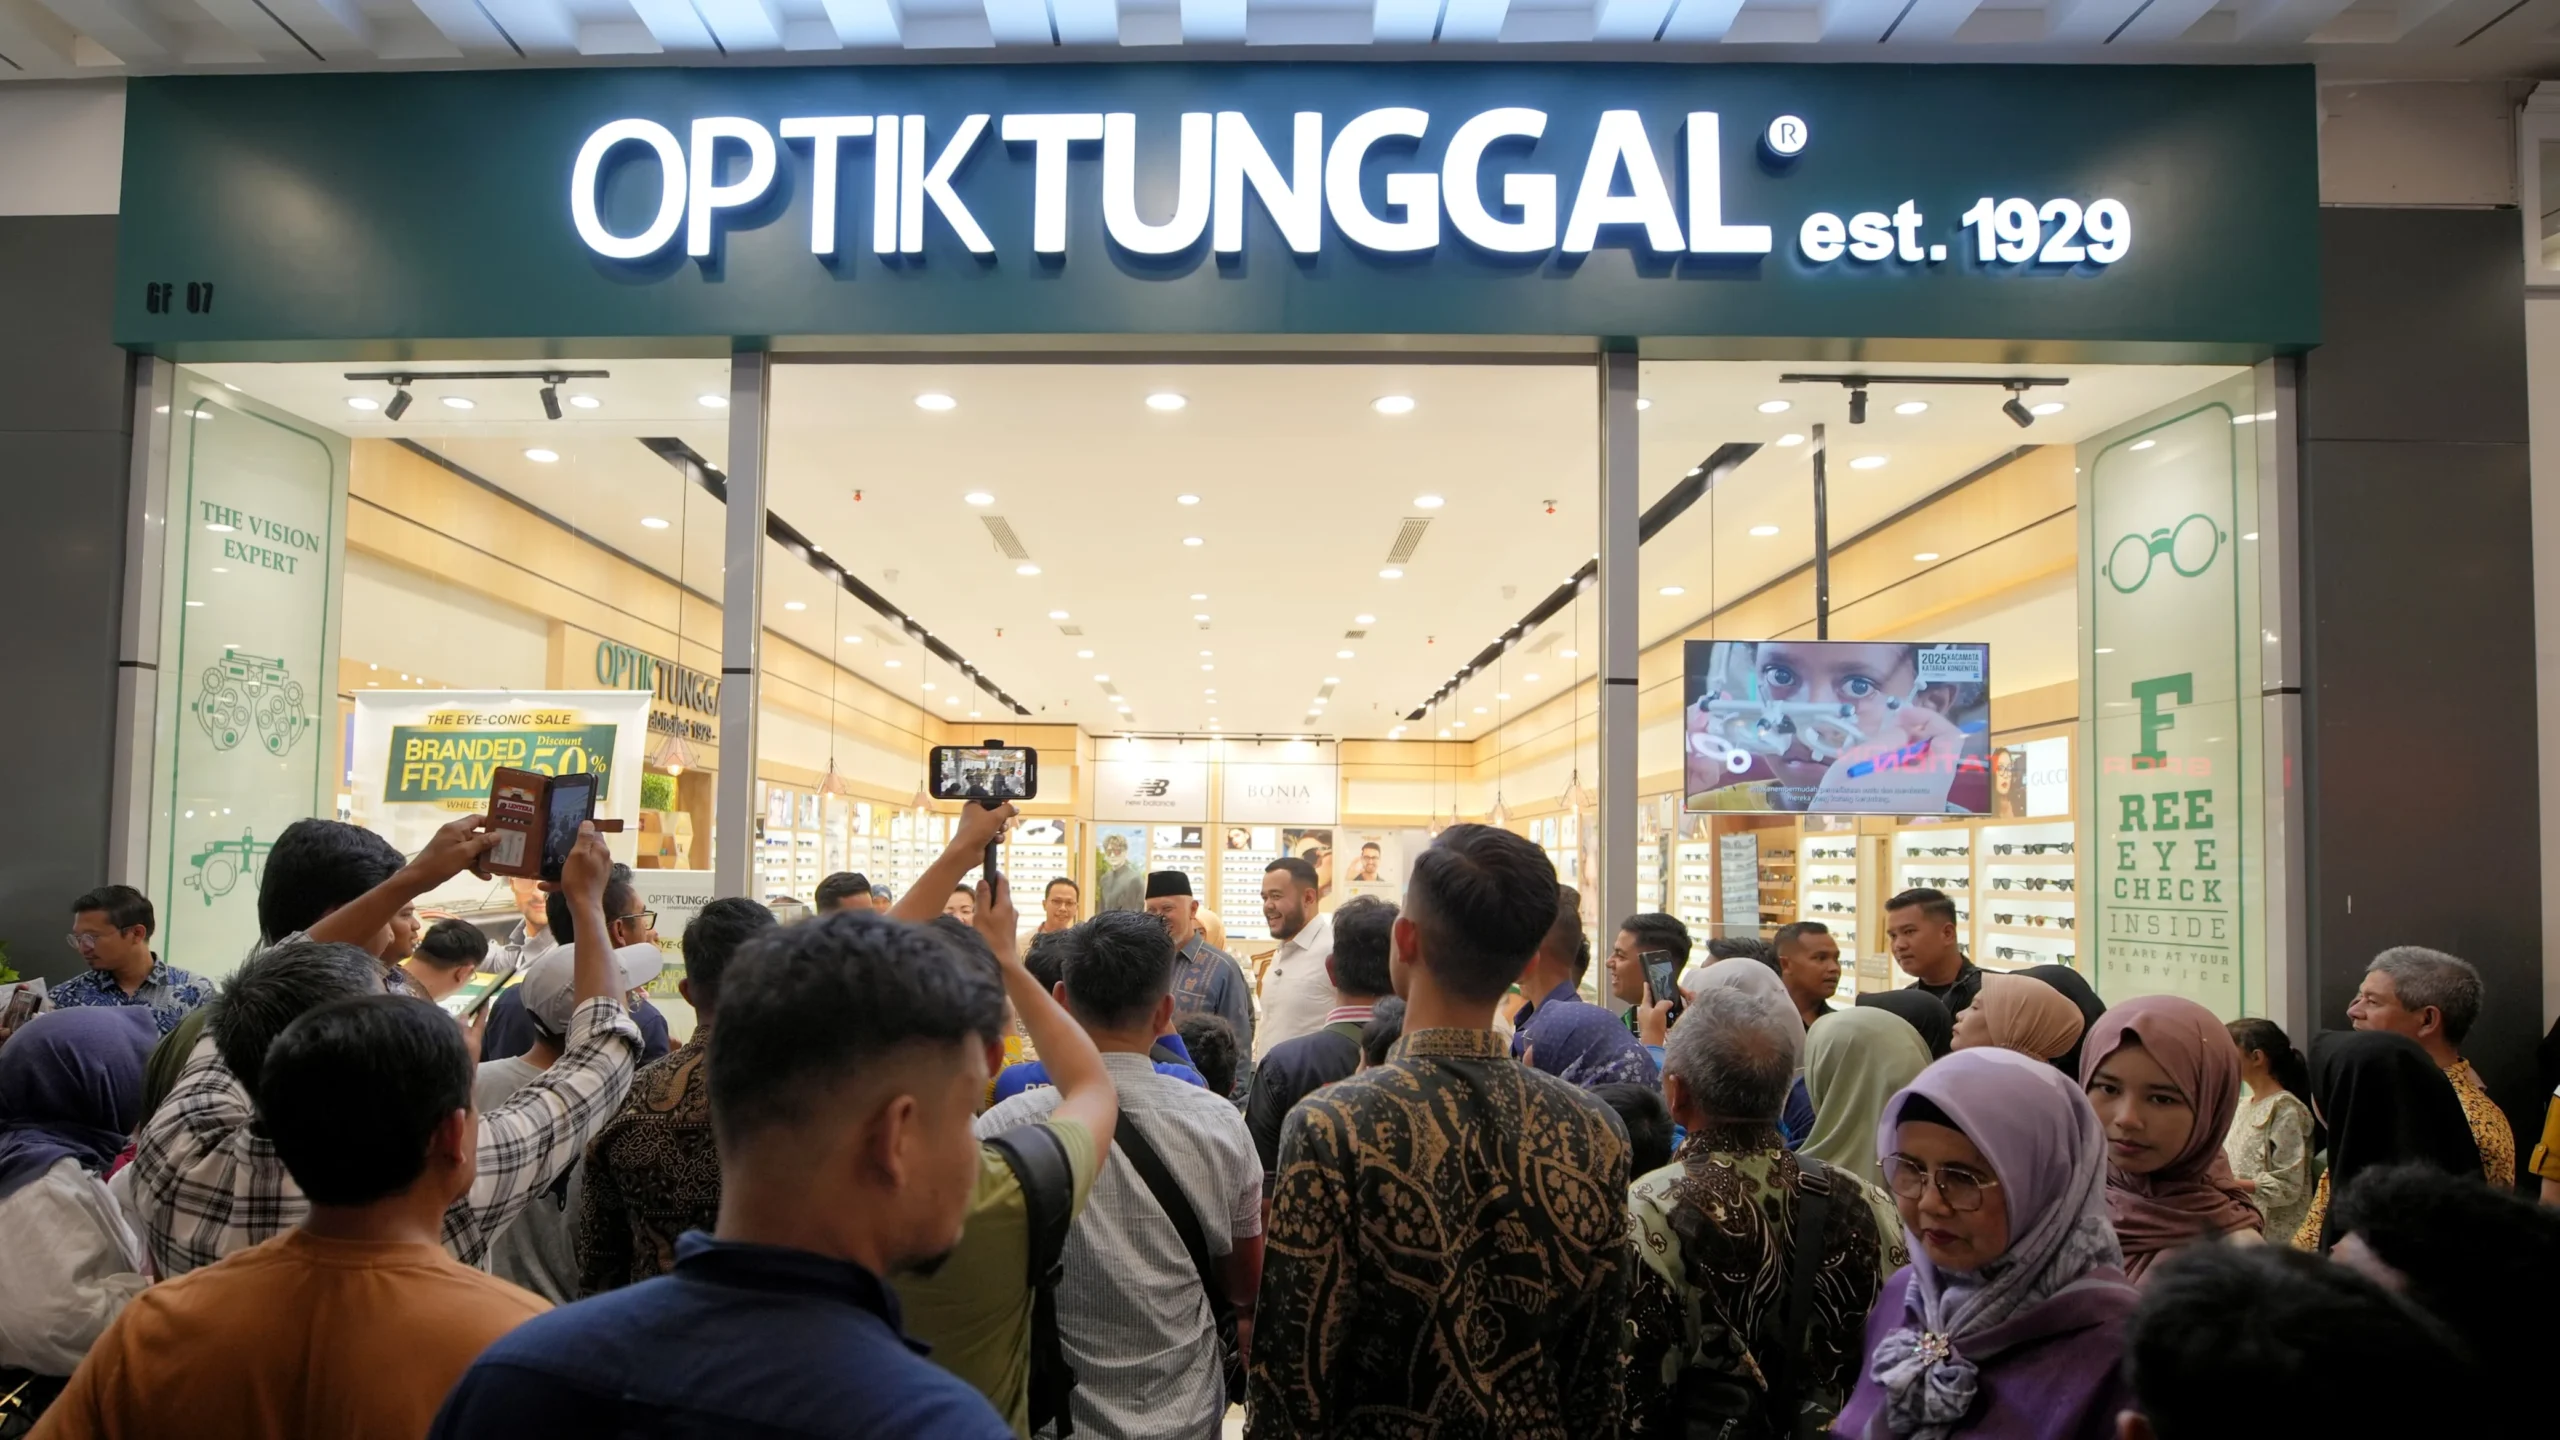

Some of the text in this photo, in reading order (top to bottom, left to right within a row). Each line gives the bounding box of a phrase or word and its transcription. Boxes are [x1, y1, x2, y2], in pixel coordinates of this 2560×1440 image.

[1799, 197, 2132, 264] est. 1929
[186, 281, 214, 315] 07
[200, 500, 320, 553] THE VISION
[224, 538, 298, 575] EXPERT
[1921, 653, 1979, 665] 2025 KACAMATA
[1922, 664, 1979, 672] KATARAK KONGENITAL
[427, 714, 571, 725] THE EYE-CONIC SALE
[405, 738, 526, 761] BRANDED
[537, 736, 582, 747] Discount
[2031, 768, 2068, 787] GUCCI
[1248, 784, 1310, 798] BONIA
[446, 800, 479, 809] WHILE
[1143, 798, 1176, 808] balance
[2119, 789, 2214, 832] REE
[2116, 839, 2216, 871] EYE
[2114, 877, 2222, 903] CHECK
[2110, 913, 2226, 940] INSIDE
[2108, 946, 2229, 966] WE ARE AT YOUR
[2108, 961, 2230, 983] SERVICE
